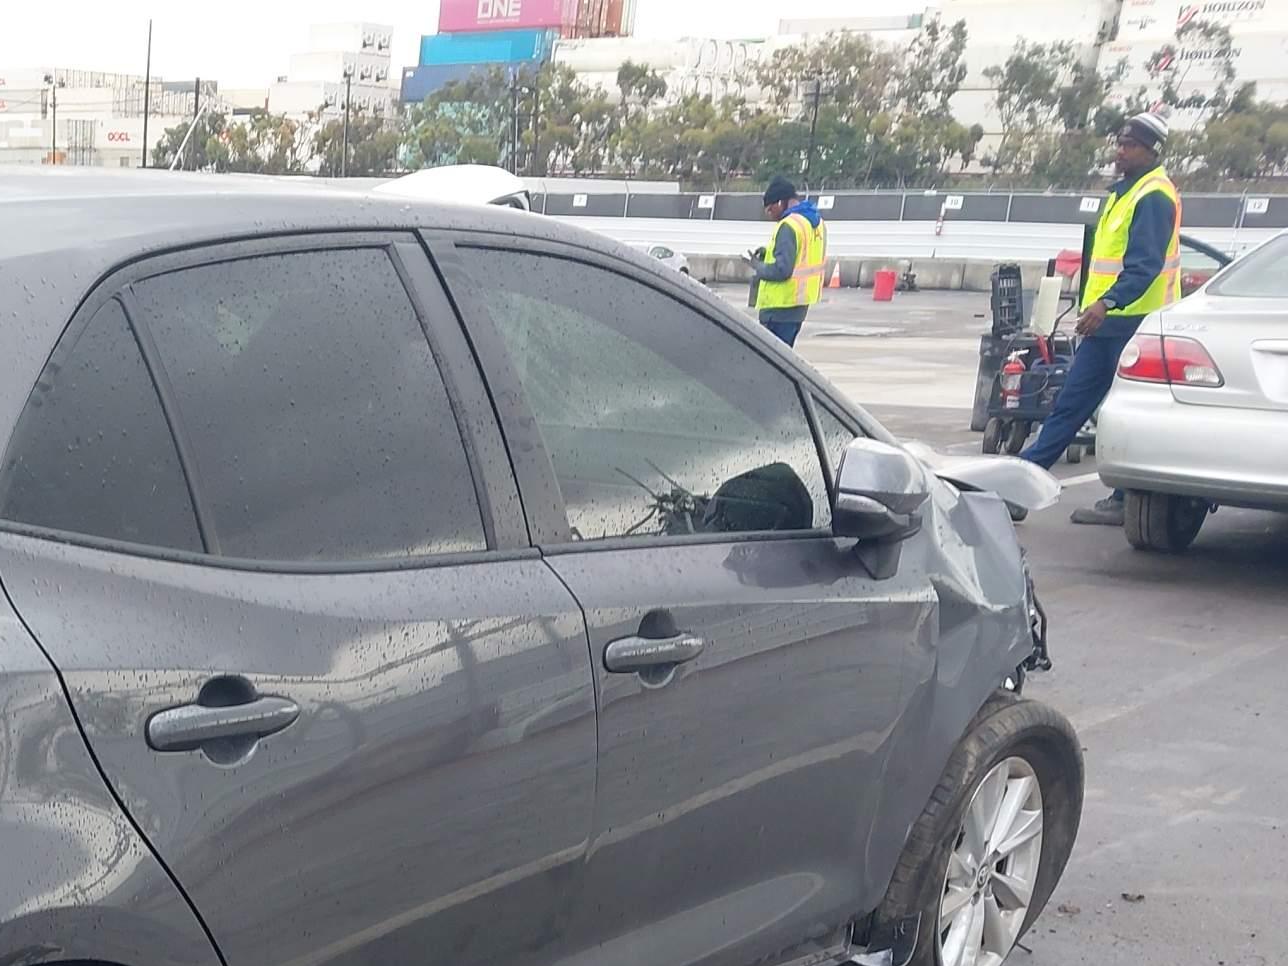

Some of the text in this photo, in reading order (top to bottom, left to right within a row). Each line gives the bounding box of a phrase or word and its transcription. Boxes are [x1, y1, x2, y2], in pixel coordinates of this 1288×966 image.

[477, 0, 521, 18] ONE
[1202, 0, 1265, 13] HORIZON
[107, 132, 131, 142] OOCL
